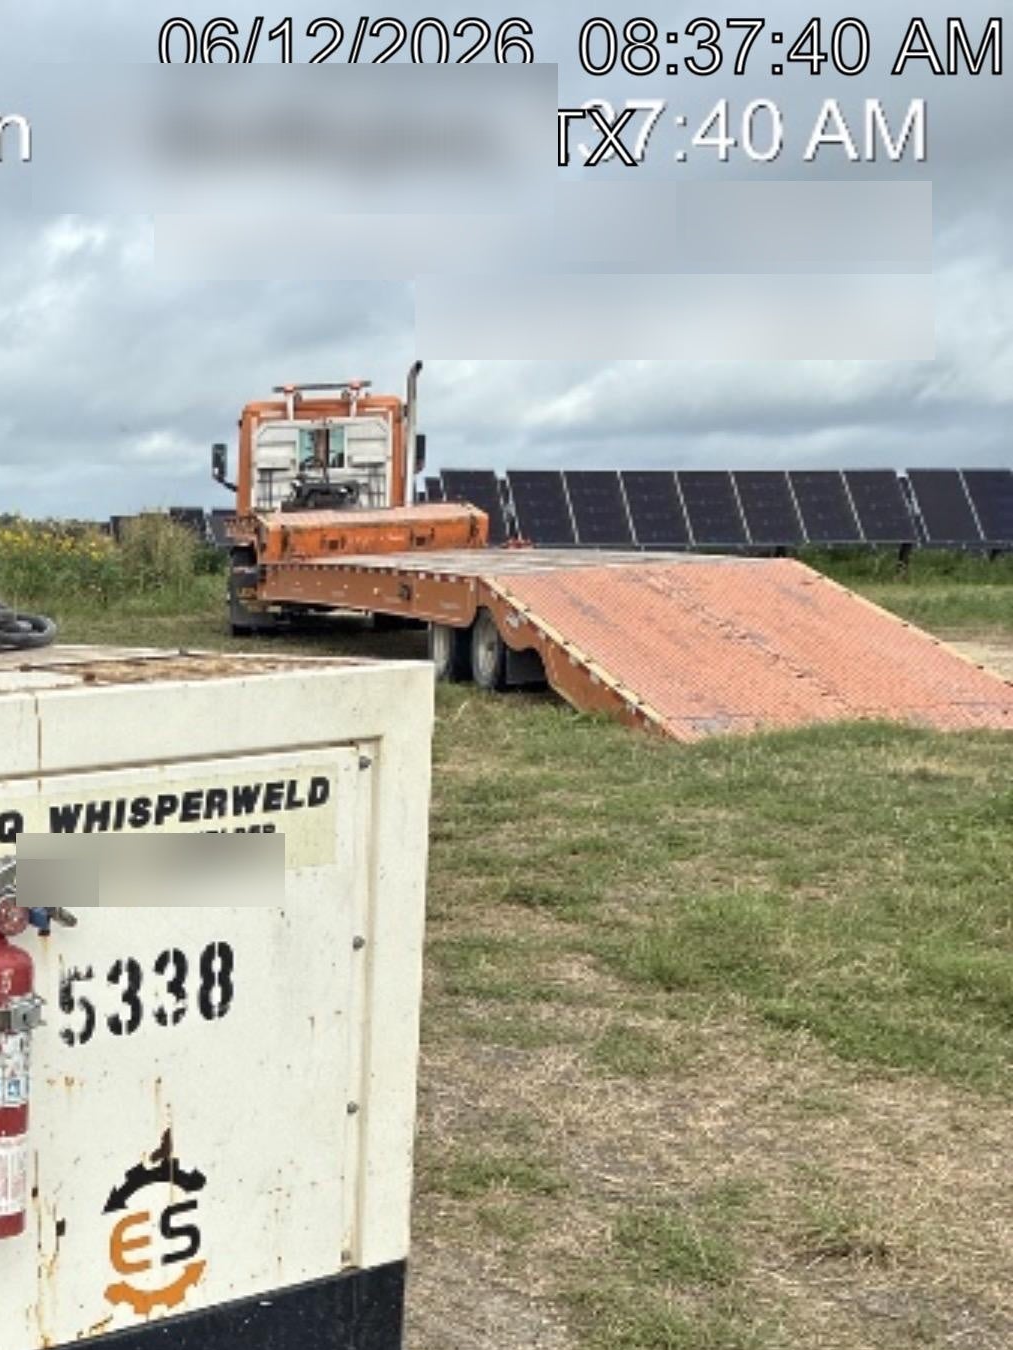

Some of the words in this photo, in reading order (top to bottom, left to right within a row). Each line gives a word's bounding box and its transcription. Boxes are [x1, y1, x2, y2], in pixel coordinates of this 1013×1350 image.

[48, 776, 331, 834] WHISPERWELD
[58, 940, 235, 1047] 5338
[109, 1199, 202, 1275] ES
